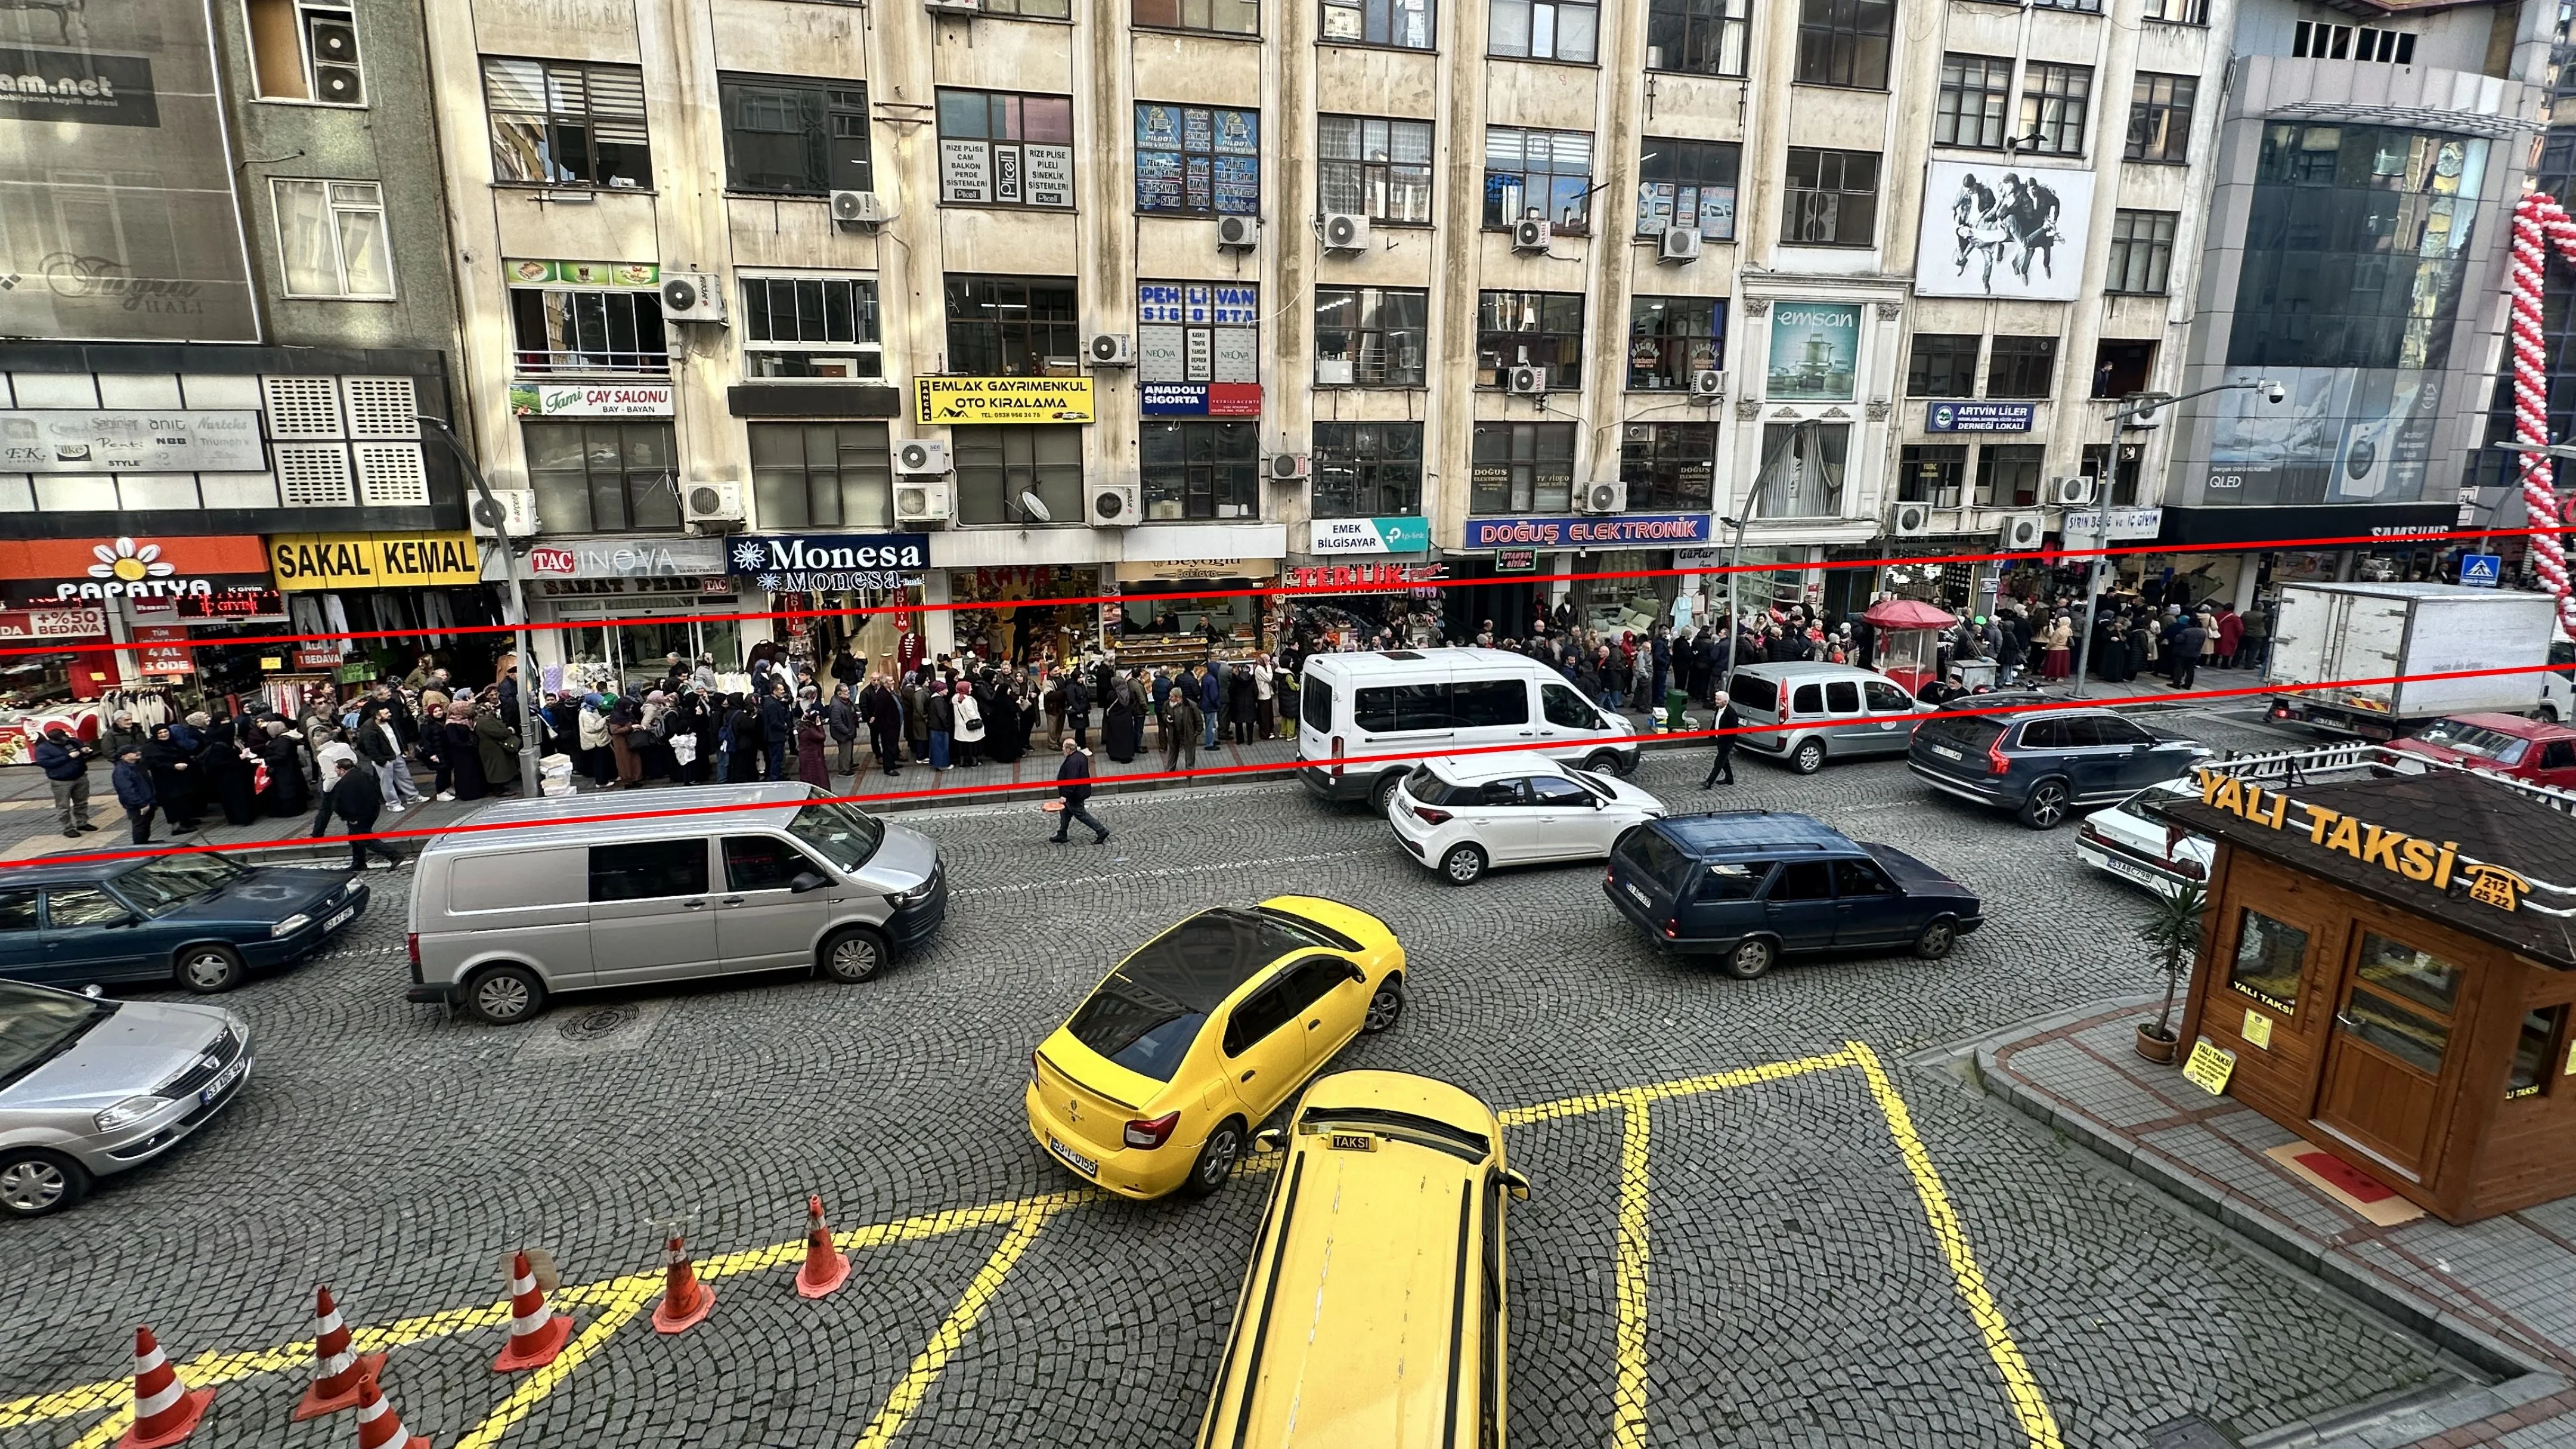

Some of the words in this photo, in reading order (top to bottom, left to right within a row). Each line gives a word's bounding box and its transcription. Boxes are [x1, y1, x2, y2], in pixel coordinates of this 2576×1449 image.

[1777, 310, 1853, 327] emsan
[932, 380, 983, 392] EMLAK
[987, 380, 1088, 392] GAYRIMENKUL
[1144, 386, 1206, 395] ANADOLU
[546, 386, 583, 414] Tami
[586, 391, 611, 406] ÇAY
[614, 390, 668, 404] SALONU
[921, 380, 931, 421] SANCAK
[955, 397, 985, 408] OTO
[989, 397, 1067, 408] KIRALAMA
[1144, 394, 1199, 404] SİGORTA
[1958, 405, 1996, 416] ARTVİN
[1998, 405, 2028, 416] LİLER
[1958, 421, 1993, 430] DERNEĞİ
[1995, 422, 2024, 430] LOKALİ
[2209, 476, 2241, 488] QLED
[1333, 524, 1361, 534] EMEK
[1401, 531, 1425, 540] tp-link
[1480, 521, 1560, 545] DOĞUŞ
[1569, 516, 1698, 541] ELEKTRONİK
[2370, 525, 2450, 544] SAMSUNG
[1317, 536, 1376, 549] BİLGİSAYAR
[277, 543, 371, 578] SAKAL
[383, 541, 476, 574] KEMAL
[768, 539, 922, 571] Monesa
[533, 552, 572, 574] TAÇ
[1177, 568, 1218, 578] Baklava
[1294, 560, 1404, 588] TERLİK
[57, 578, 212, 600] PAPATYA
[705, 580, 726, 592] TAÇ
[785, 571, 901, 592] Monesa
[38, 610, 98, 625] +%50
[38, 624, 101, 635] BEDAVA
[151, 627, 169, 637] TÜM
[148, 648, 157, 657] 4
[159, 646, 181, 657] AL
[305, 654, 342, 664] BEDAVA
[144, 662, 154, 671] 3
[156, 660, 191, 671] ÖDE
[2199, 769, 2291, 831] YALI
[2305, 804, 2462, 890] TAKSİ
[2483, 876, 2507, 894] 212
[2473, 888, 2492, 903] 25
[2492, 893, 2510, 909] 22
[2234, 980, 2258, 999] YALI
[2260, 993, 2295, 1016] TAKSİ
[2197, 1043, 2213, 1057] YALI
[206, 1086, 218, 1098] 53
[1054, 1139, 1064, 1152] 53
[1075, 1154, 1095, 1172] 0155
